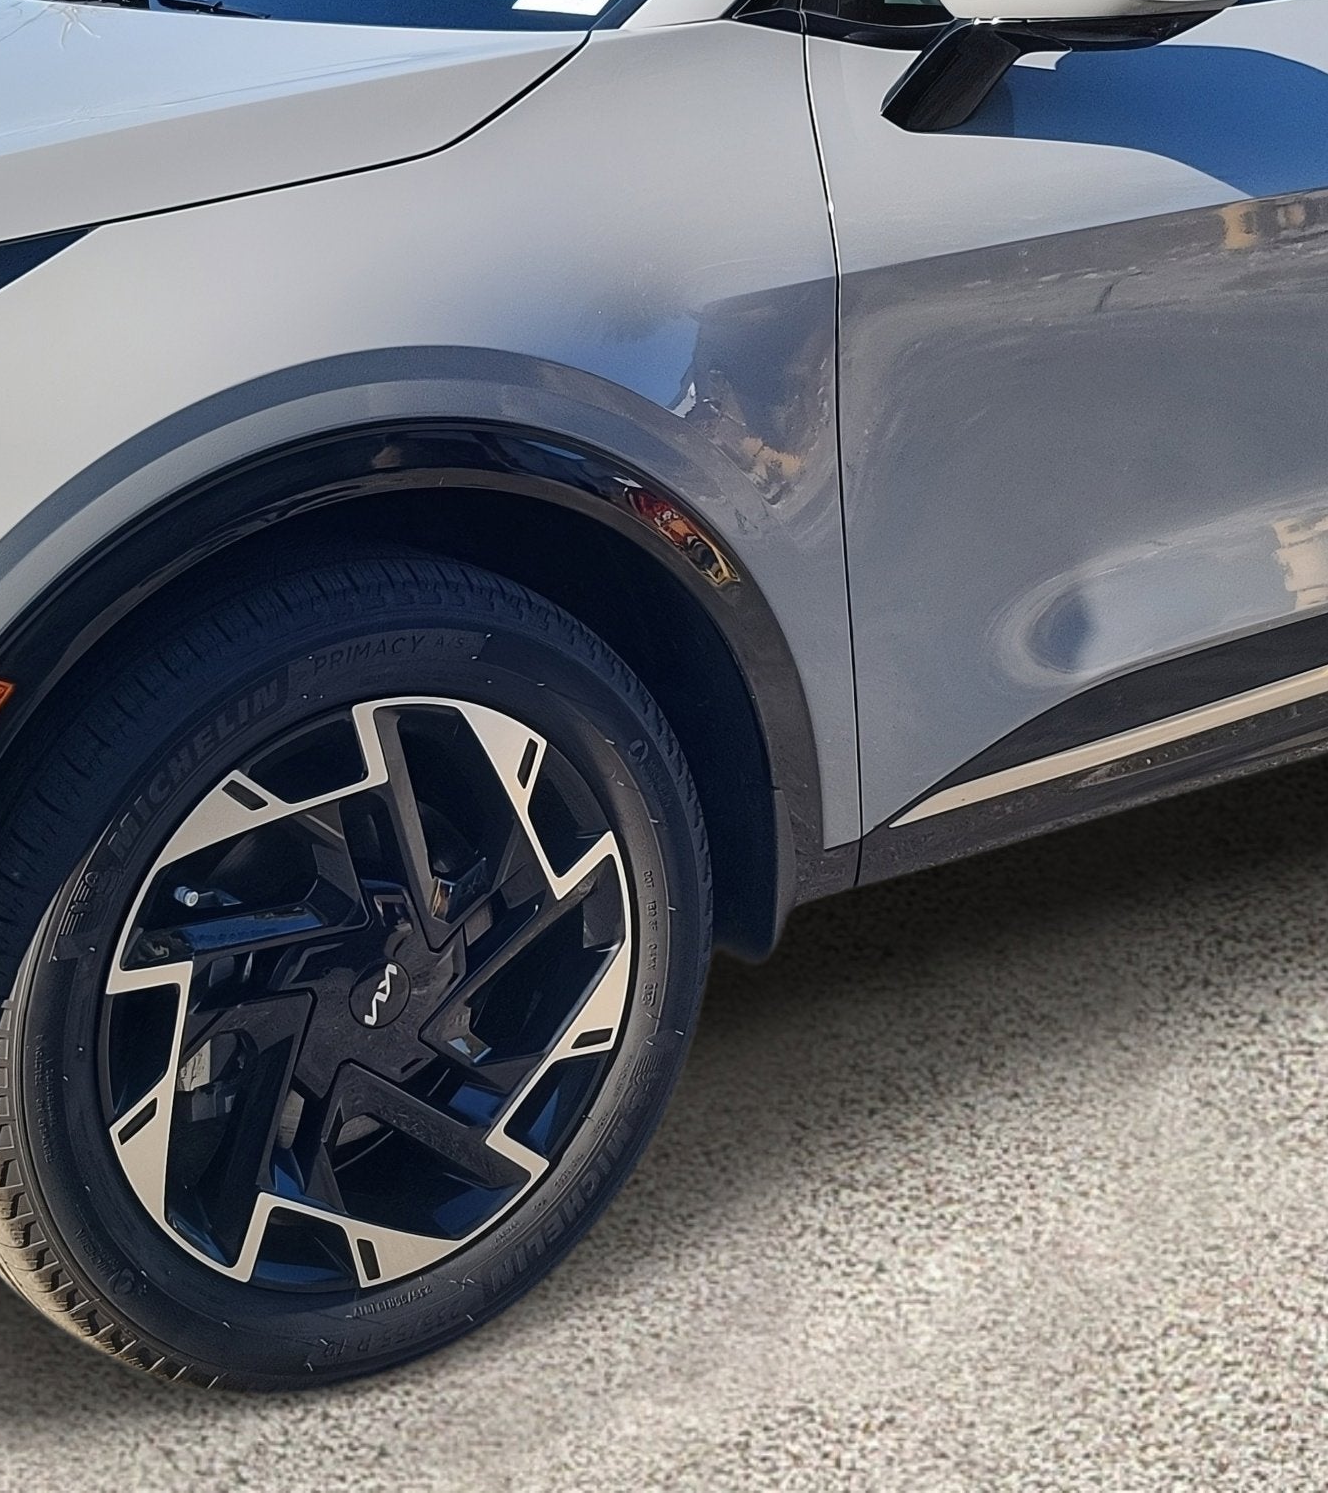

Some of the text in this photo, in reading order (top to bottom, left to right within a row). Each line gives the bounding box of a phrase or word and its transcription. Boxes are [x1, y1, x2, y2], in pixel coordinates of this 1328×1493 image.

[105, 675, 281, 864] MICHELIN
[312, 634, 426, 676] PRIMACY
[488, 1117, 624, 1295] MICHELIN
